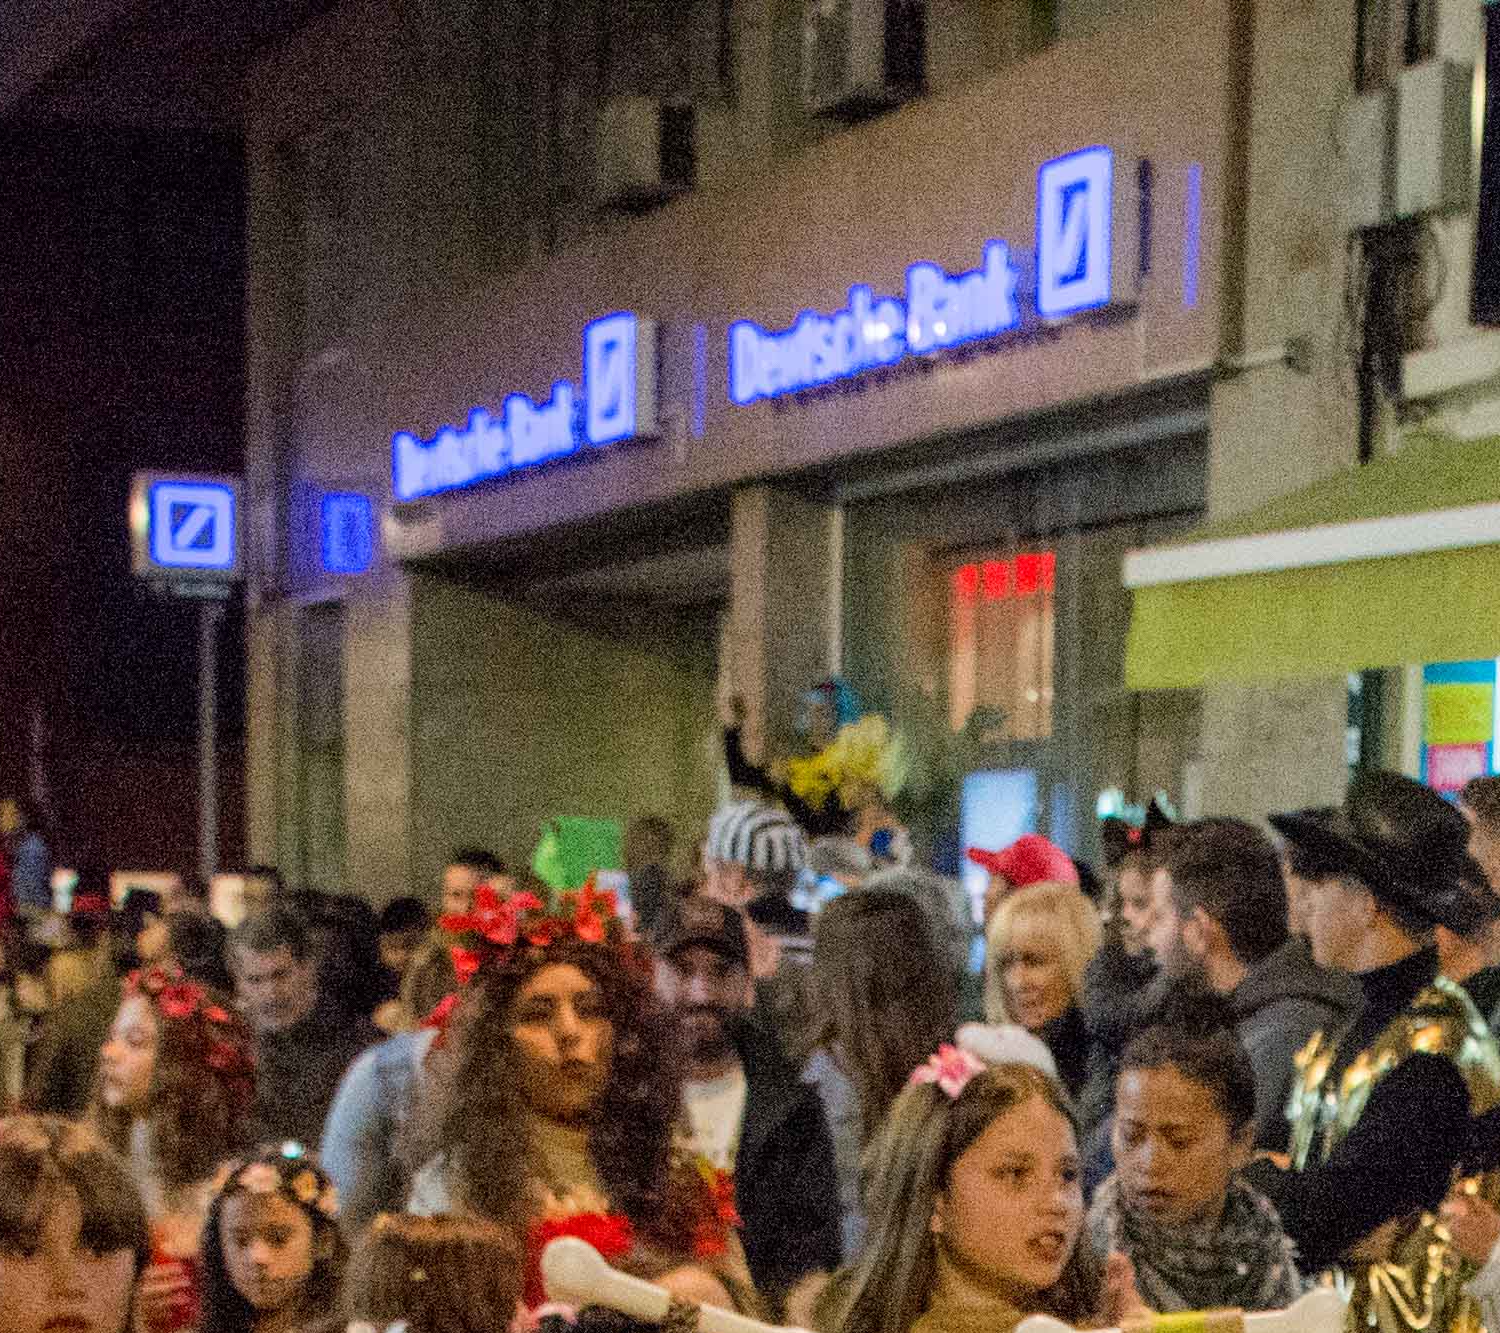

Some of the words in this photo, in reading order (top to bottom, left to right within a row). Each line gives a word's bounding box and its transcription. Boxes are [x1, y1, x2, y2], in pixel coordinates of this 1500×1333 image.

[728, 281, 905, 406] Deutsche
[903, 238, 1021, 356] Bank
[504, 377, 580, 471] Bank
